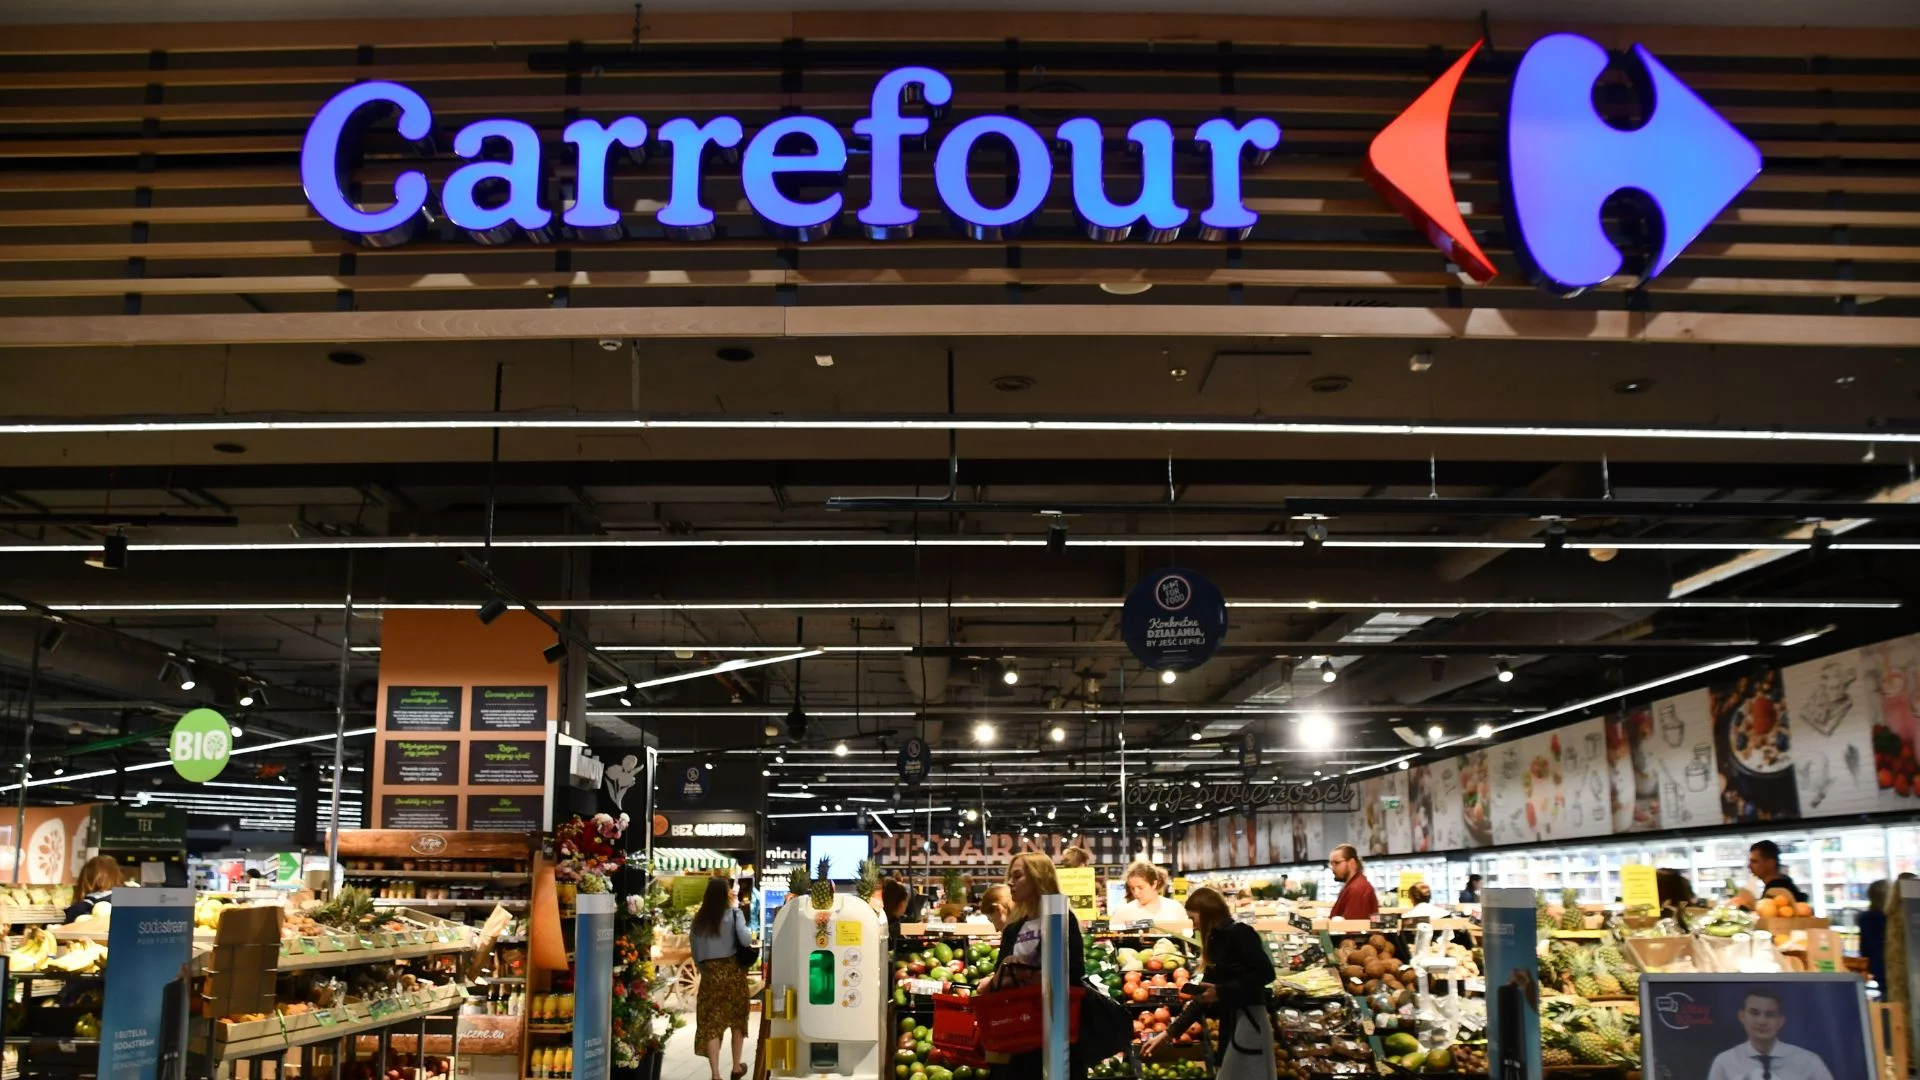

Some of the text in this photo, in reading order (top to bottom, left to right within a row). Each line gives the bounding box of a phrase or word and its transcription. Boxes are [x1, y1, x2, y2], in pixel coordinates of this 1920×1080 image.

[301, 66, 1281, 234] Carrefour
[1149, 616, 1199, 629] Konkretne
[1179, 637, 1206, 646] LEPIEJ
[175, 730, 228, 760] BIO
[671, 824, 694, 836] BEZ
[138, 919, 188, 934] sodastream
